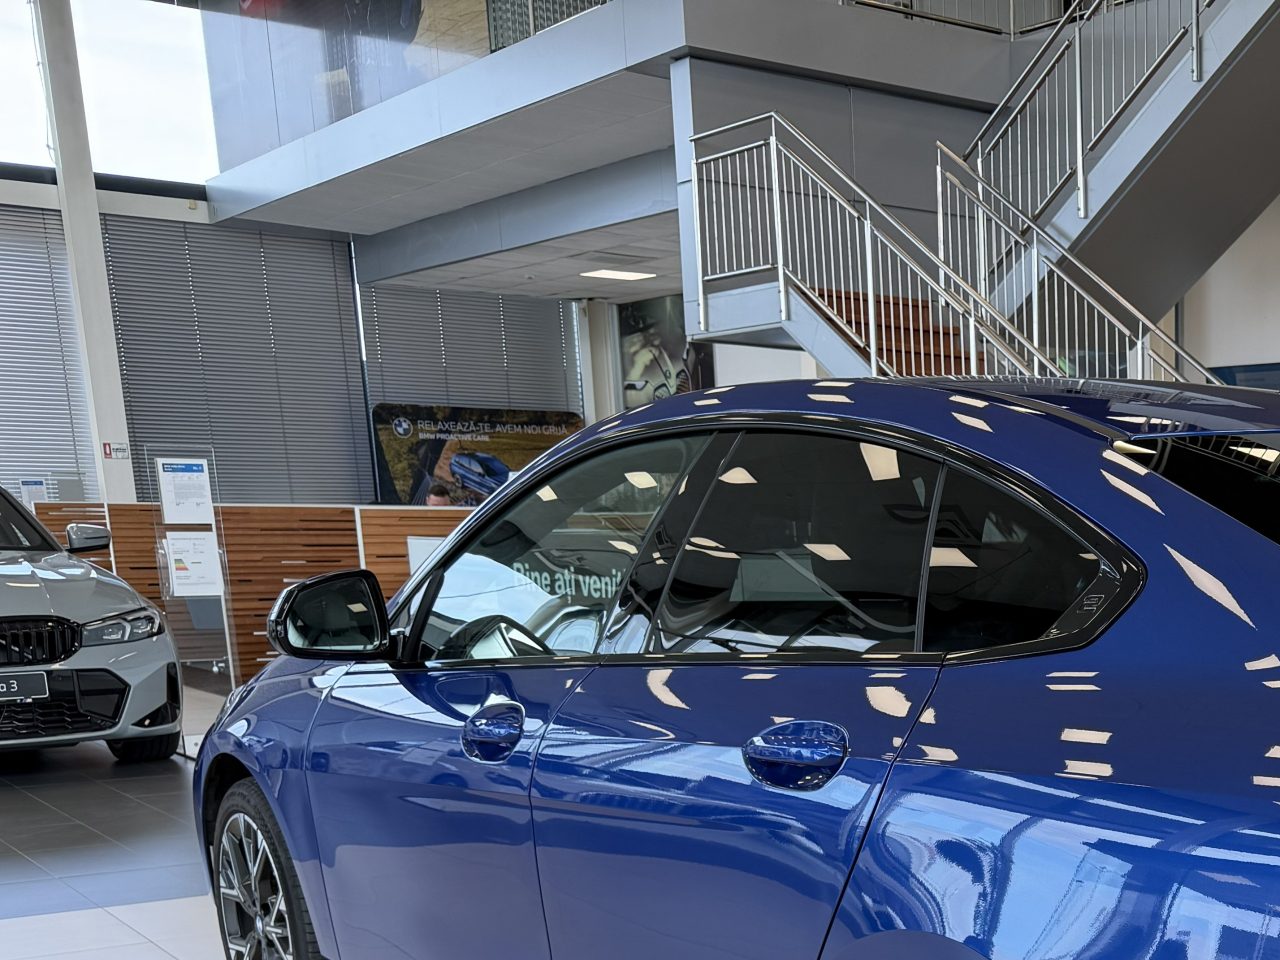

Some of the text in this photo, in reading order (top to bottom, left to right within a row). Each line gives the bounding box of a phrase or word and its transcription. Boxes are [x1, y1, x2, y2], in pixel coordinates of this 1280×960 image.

[495, 423, 522, 434] AVEM
[523, 424, 541, 434] NOI
[418, 432, 435, 440] BMW
[9, 680, 18, 692] 3
